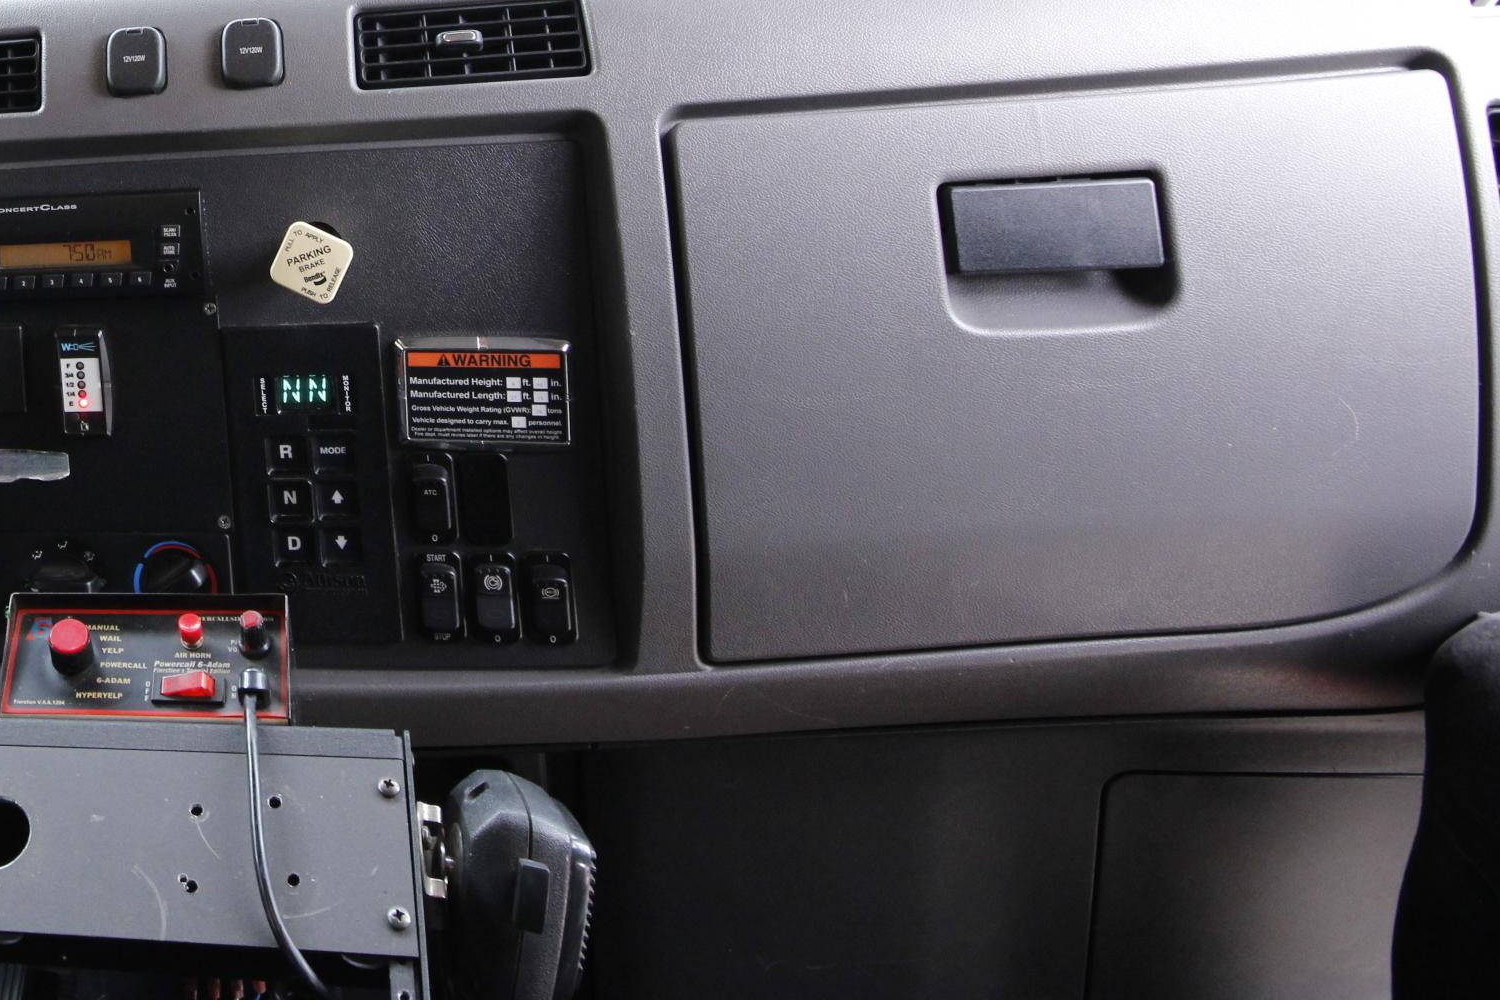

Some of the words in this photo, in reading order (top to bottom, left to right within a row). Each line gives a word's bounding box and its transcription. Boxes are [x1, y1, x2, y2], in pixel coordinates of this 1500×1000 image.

[293, 229, 303, 237] TO
[305, 232, 324, 243] APPLY
[286, 245, 331, 267] PARKING
[298, 259, 325, 273] BRAKE
[301, 287, 317, 297] PUSH
[319, 292, 329, 300] TO
[327, 267, 341, 293] RELEASE
[452, 354, 531, 367] WARNING
[409, 376, 469, 386] Manufactured
[471, 378, 503, 388] Height:
[521, 379, 531, 387] ft.
[550, 379, 562, 387] in.
[260, 377, 269, 414] SELECT
[342, 374, 352, 413] MONITOR
[410, 390, 470, 399] Manufactured
[472, 391, 506, 401] Length:
[522, 391, 531, 400] ft.
[550, 392, 562, 400] in.
[456, 406, 479, 414] Weight
[480, 407, 502, 415] Rating
[503, 407, 532, 415] (GVWR):
[436, 417, 465, 425] designed
[279, 444, 293, 459] R
[319, 446, 347, 455] MODE
[283, 490, 298, 504] N
[287, 536, 302, 551] D
[426, 554, 446, 562] START
[434, 632, 451, 640] STOP
[100, 661, 148, 669] POWERCALL
[153, 660, 196, 668] Powercall
[75, 691, 123, 699] HYPERYELP
